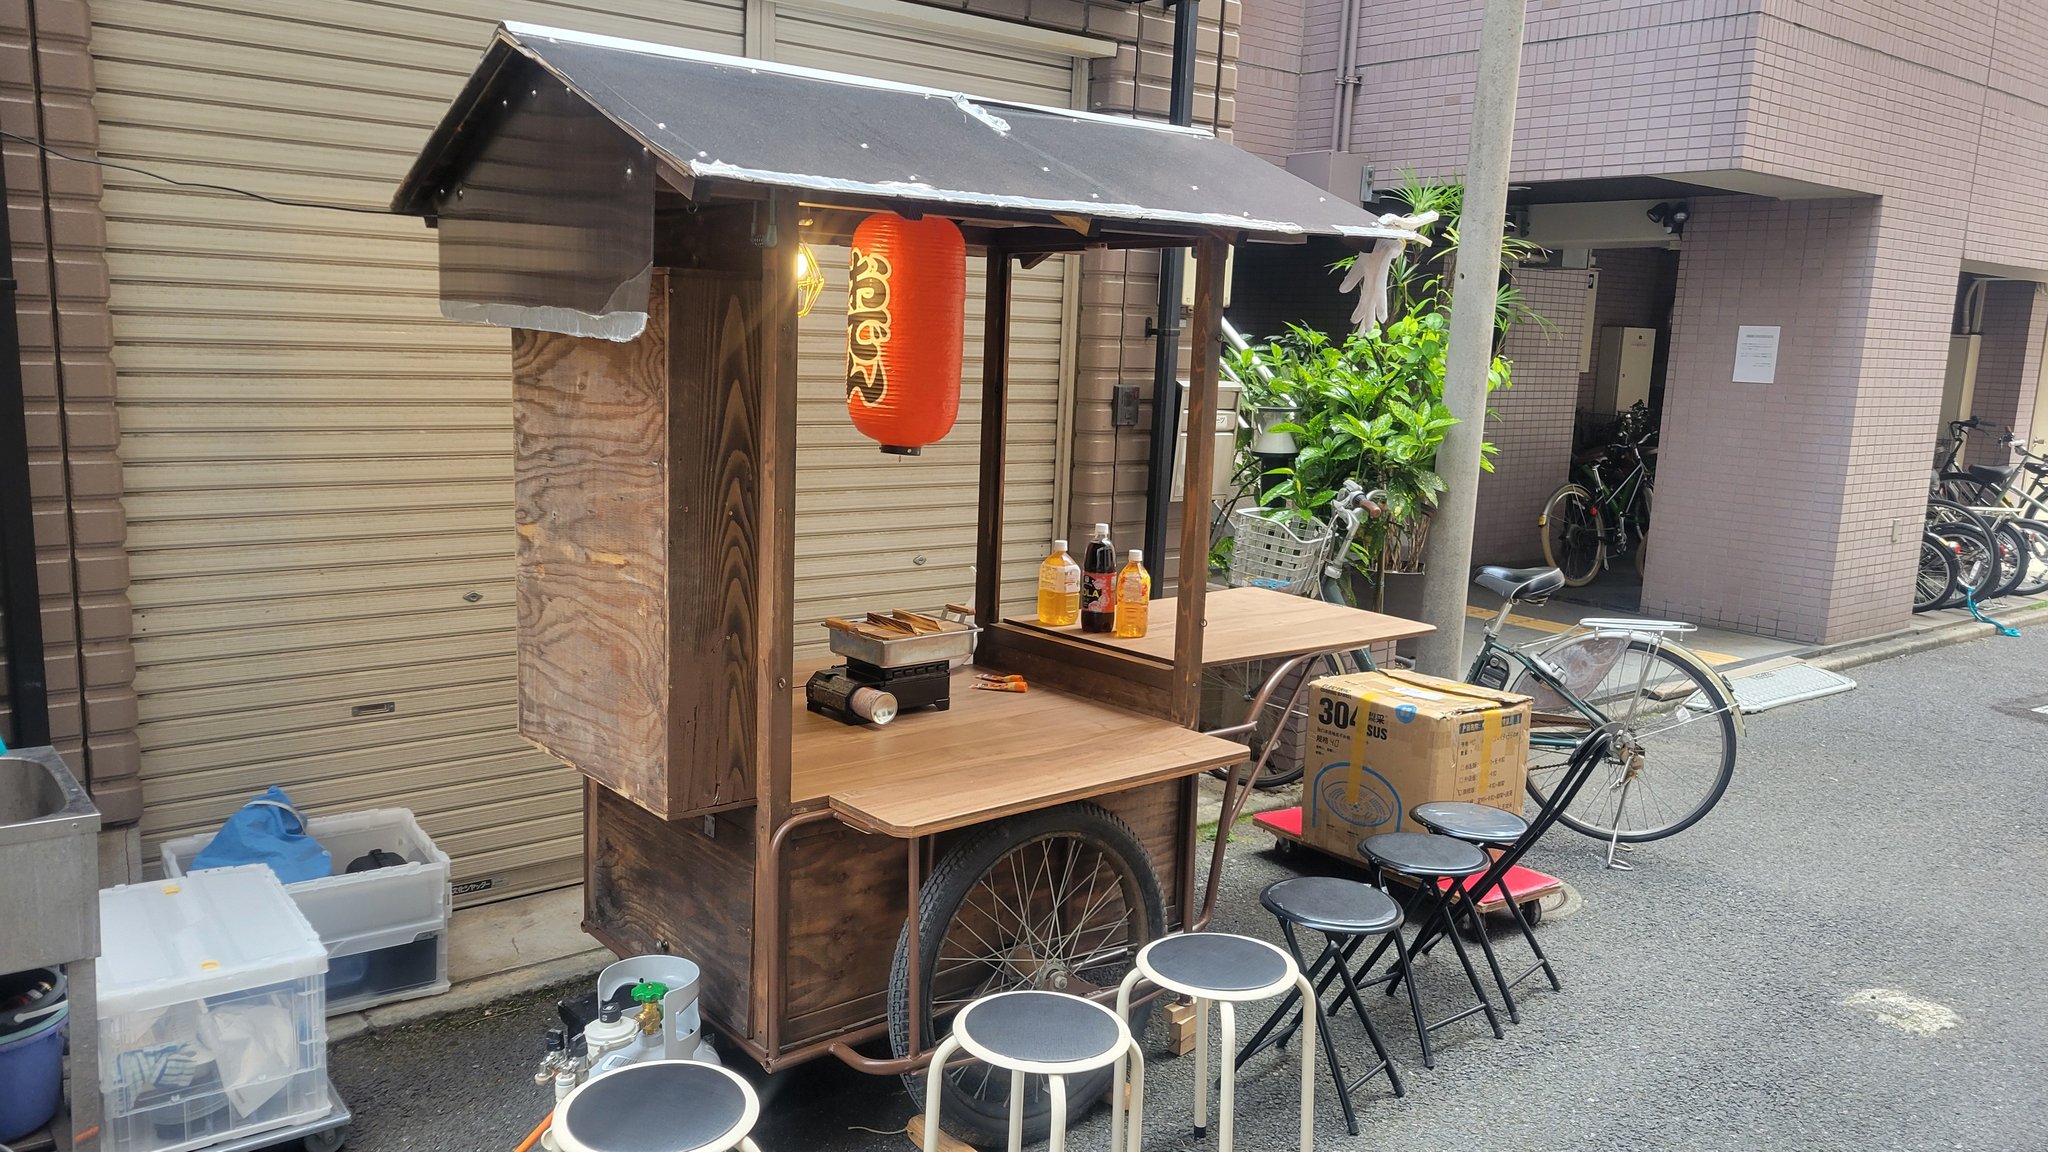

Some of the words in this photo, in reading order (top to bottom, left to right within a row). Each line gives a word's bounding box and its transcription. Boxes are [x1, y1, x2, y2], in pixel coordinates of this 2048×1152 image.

[847, 248, 893, 408] おでん
[1366, 725, 1388, 740] SUS
